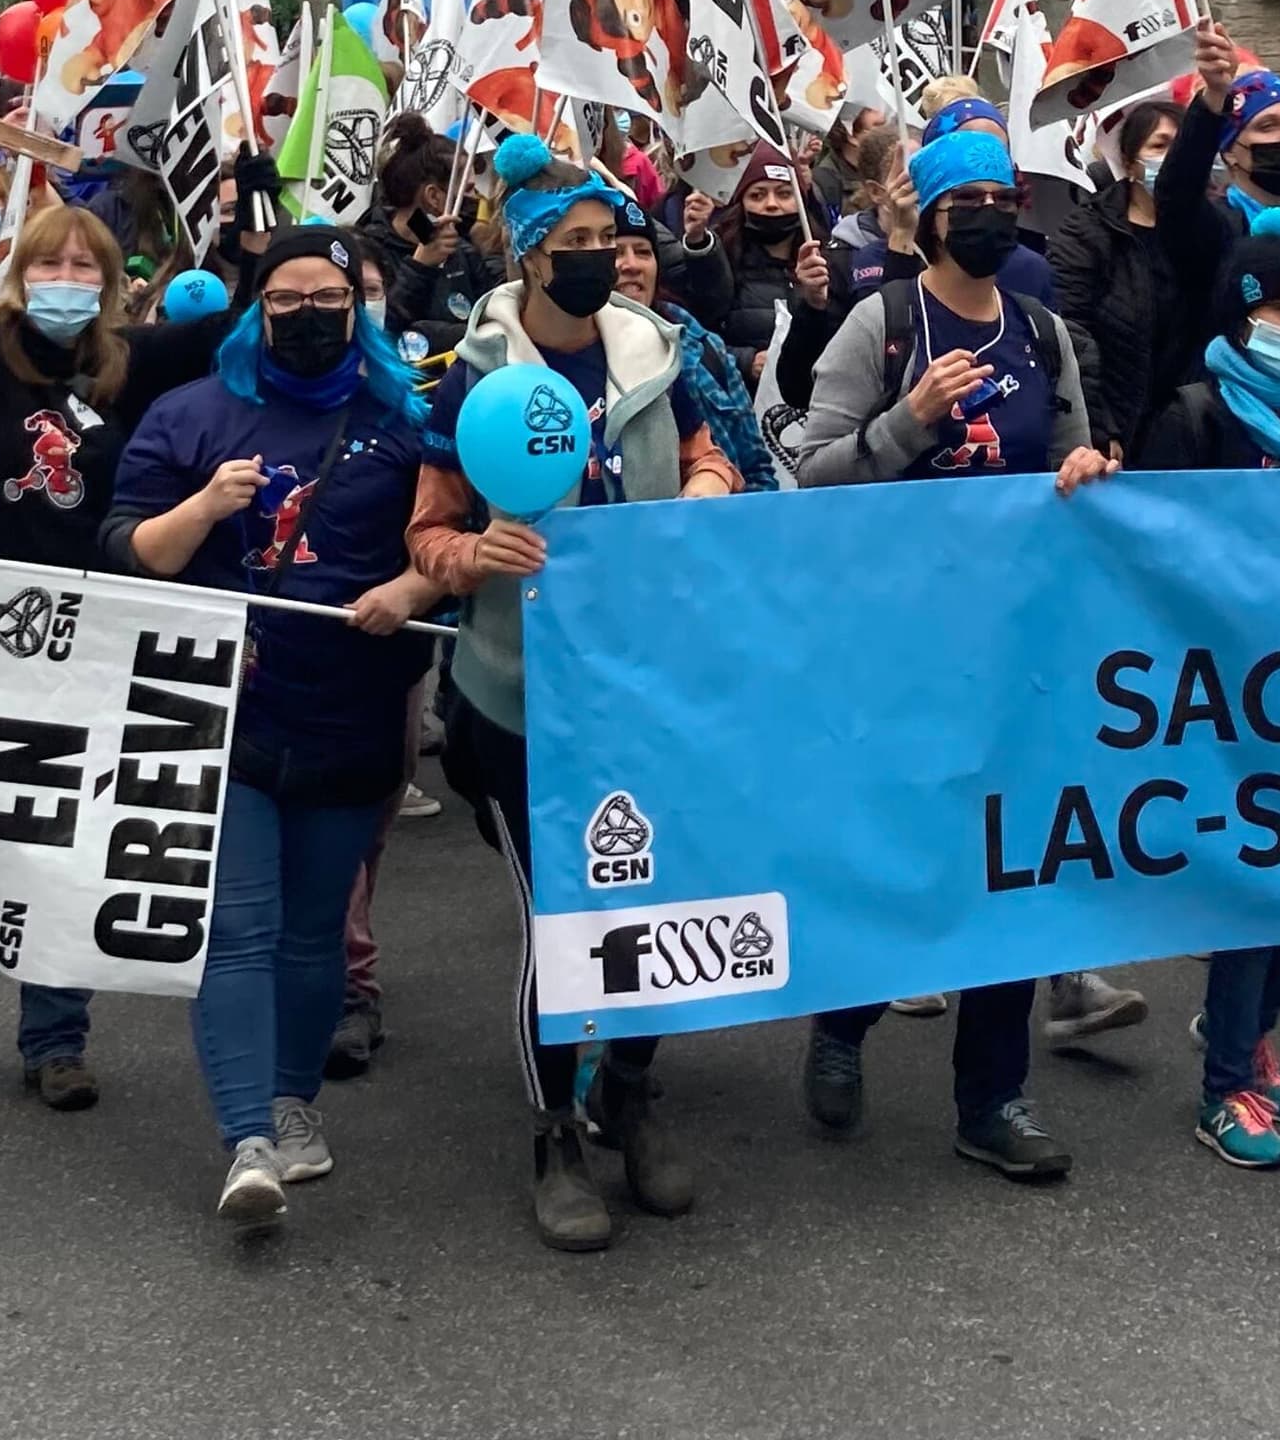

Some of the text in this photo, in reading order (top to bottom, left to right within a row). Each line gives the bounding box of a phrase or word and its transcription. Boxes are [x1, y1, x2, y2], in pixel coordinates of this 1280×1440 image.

[527, 434, 576, 456] CSN
[47, 591, 84, 662] CSN
[93, 630, 238, 965] GRÈVE
[592, 857, 650, 884] CSN
[590, 915, 774, 994] fsss CSN
